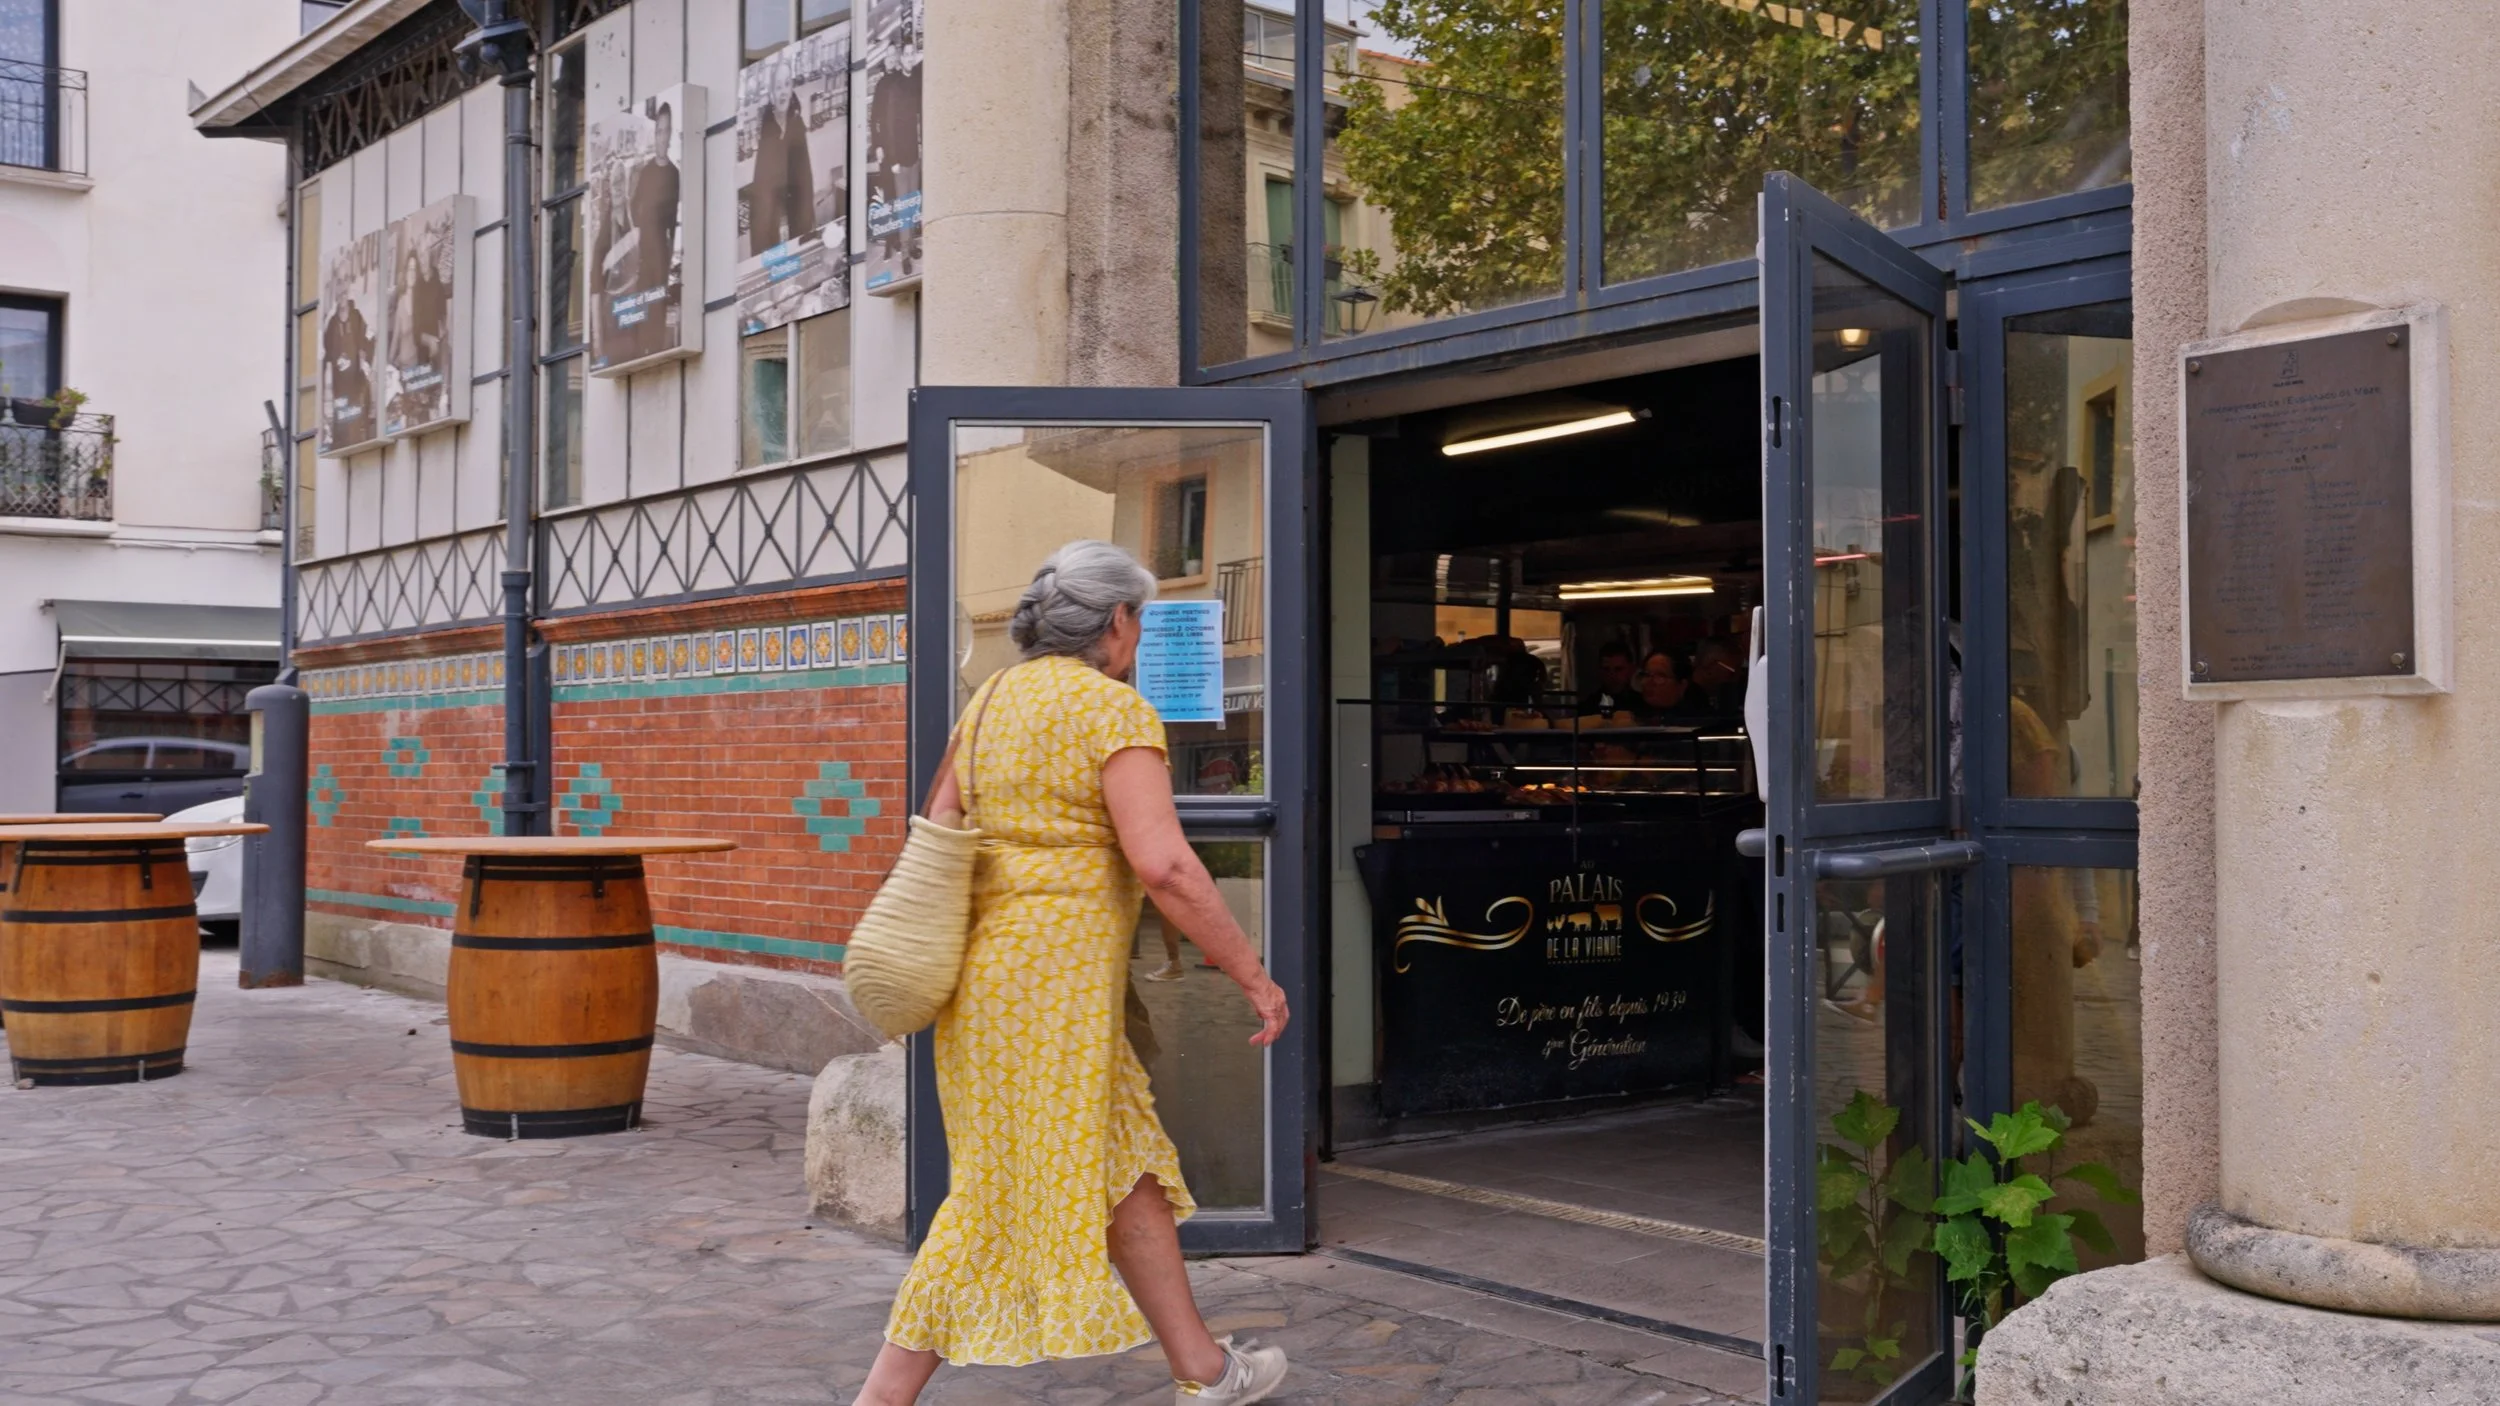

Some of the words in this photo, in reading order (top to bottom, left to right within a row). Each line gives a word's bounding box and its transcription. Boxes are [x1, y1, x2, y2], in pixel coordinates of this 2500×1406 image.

[1549, 873, 1623, 903] PALAIS
[1546, 937, 1559, 959] DE
[1564, 937, 1580, 958] LA
[1585, 935, 1622, 957] VIANDE
[1496, 996, 1527, 1027] De
[1527, 1003, 1556, 1031] père
[1559, 1005, 1576, 1020] en
[1576, 995, 1604, 1029] fils
[1609, 994, 1648, 1025] depuis
[1653, 990, 1687, 1013] 1939
[1567, 1028, 1647, 1071] Génération
